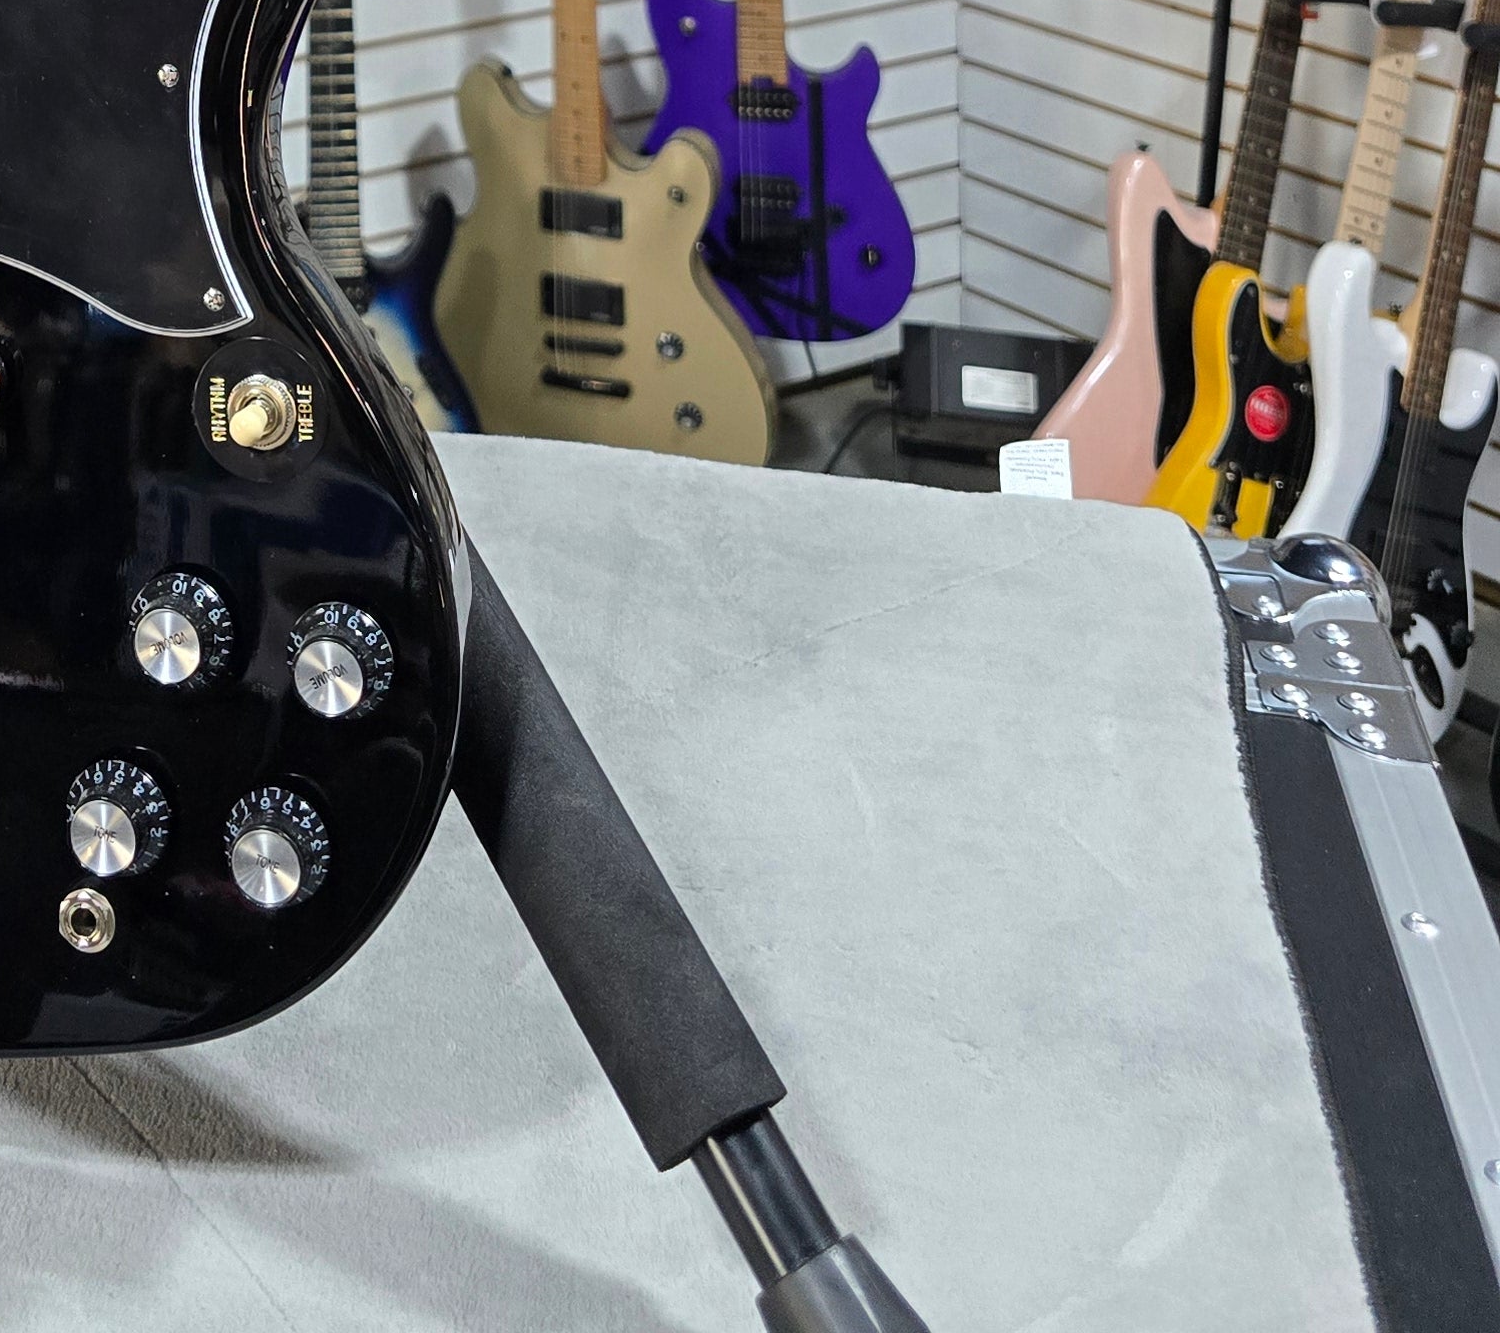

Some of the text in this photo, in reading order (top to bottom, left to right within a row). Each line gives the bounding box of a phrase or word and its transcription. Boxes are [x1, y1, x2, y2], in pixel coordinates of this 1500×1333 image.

[209, 377, 227, 442] RHYTHM
[296, 384, 314, 443] TREBLE
[324, 610, 339, 625] 10
[149, 631, 188, 656] VOLUME
[309, 663, 348, 690] VOLUME
[260, 797, 271, 810] 6
[300, 815, 311, 829] 4
[94, 825, 117, 844] TONE
[255, 853, 281, 875] TONE
